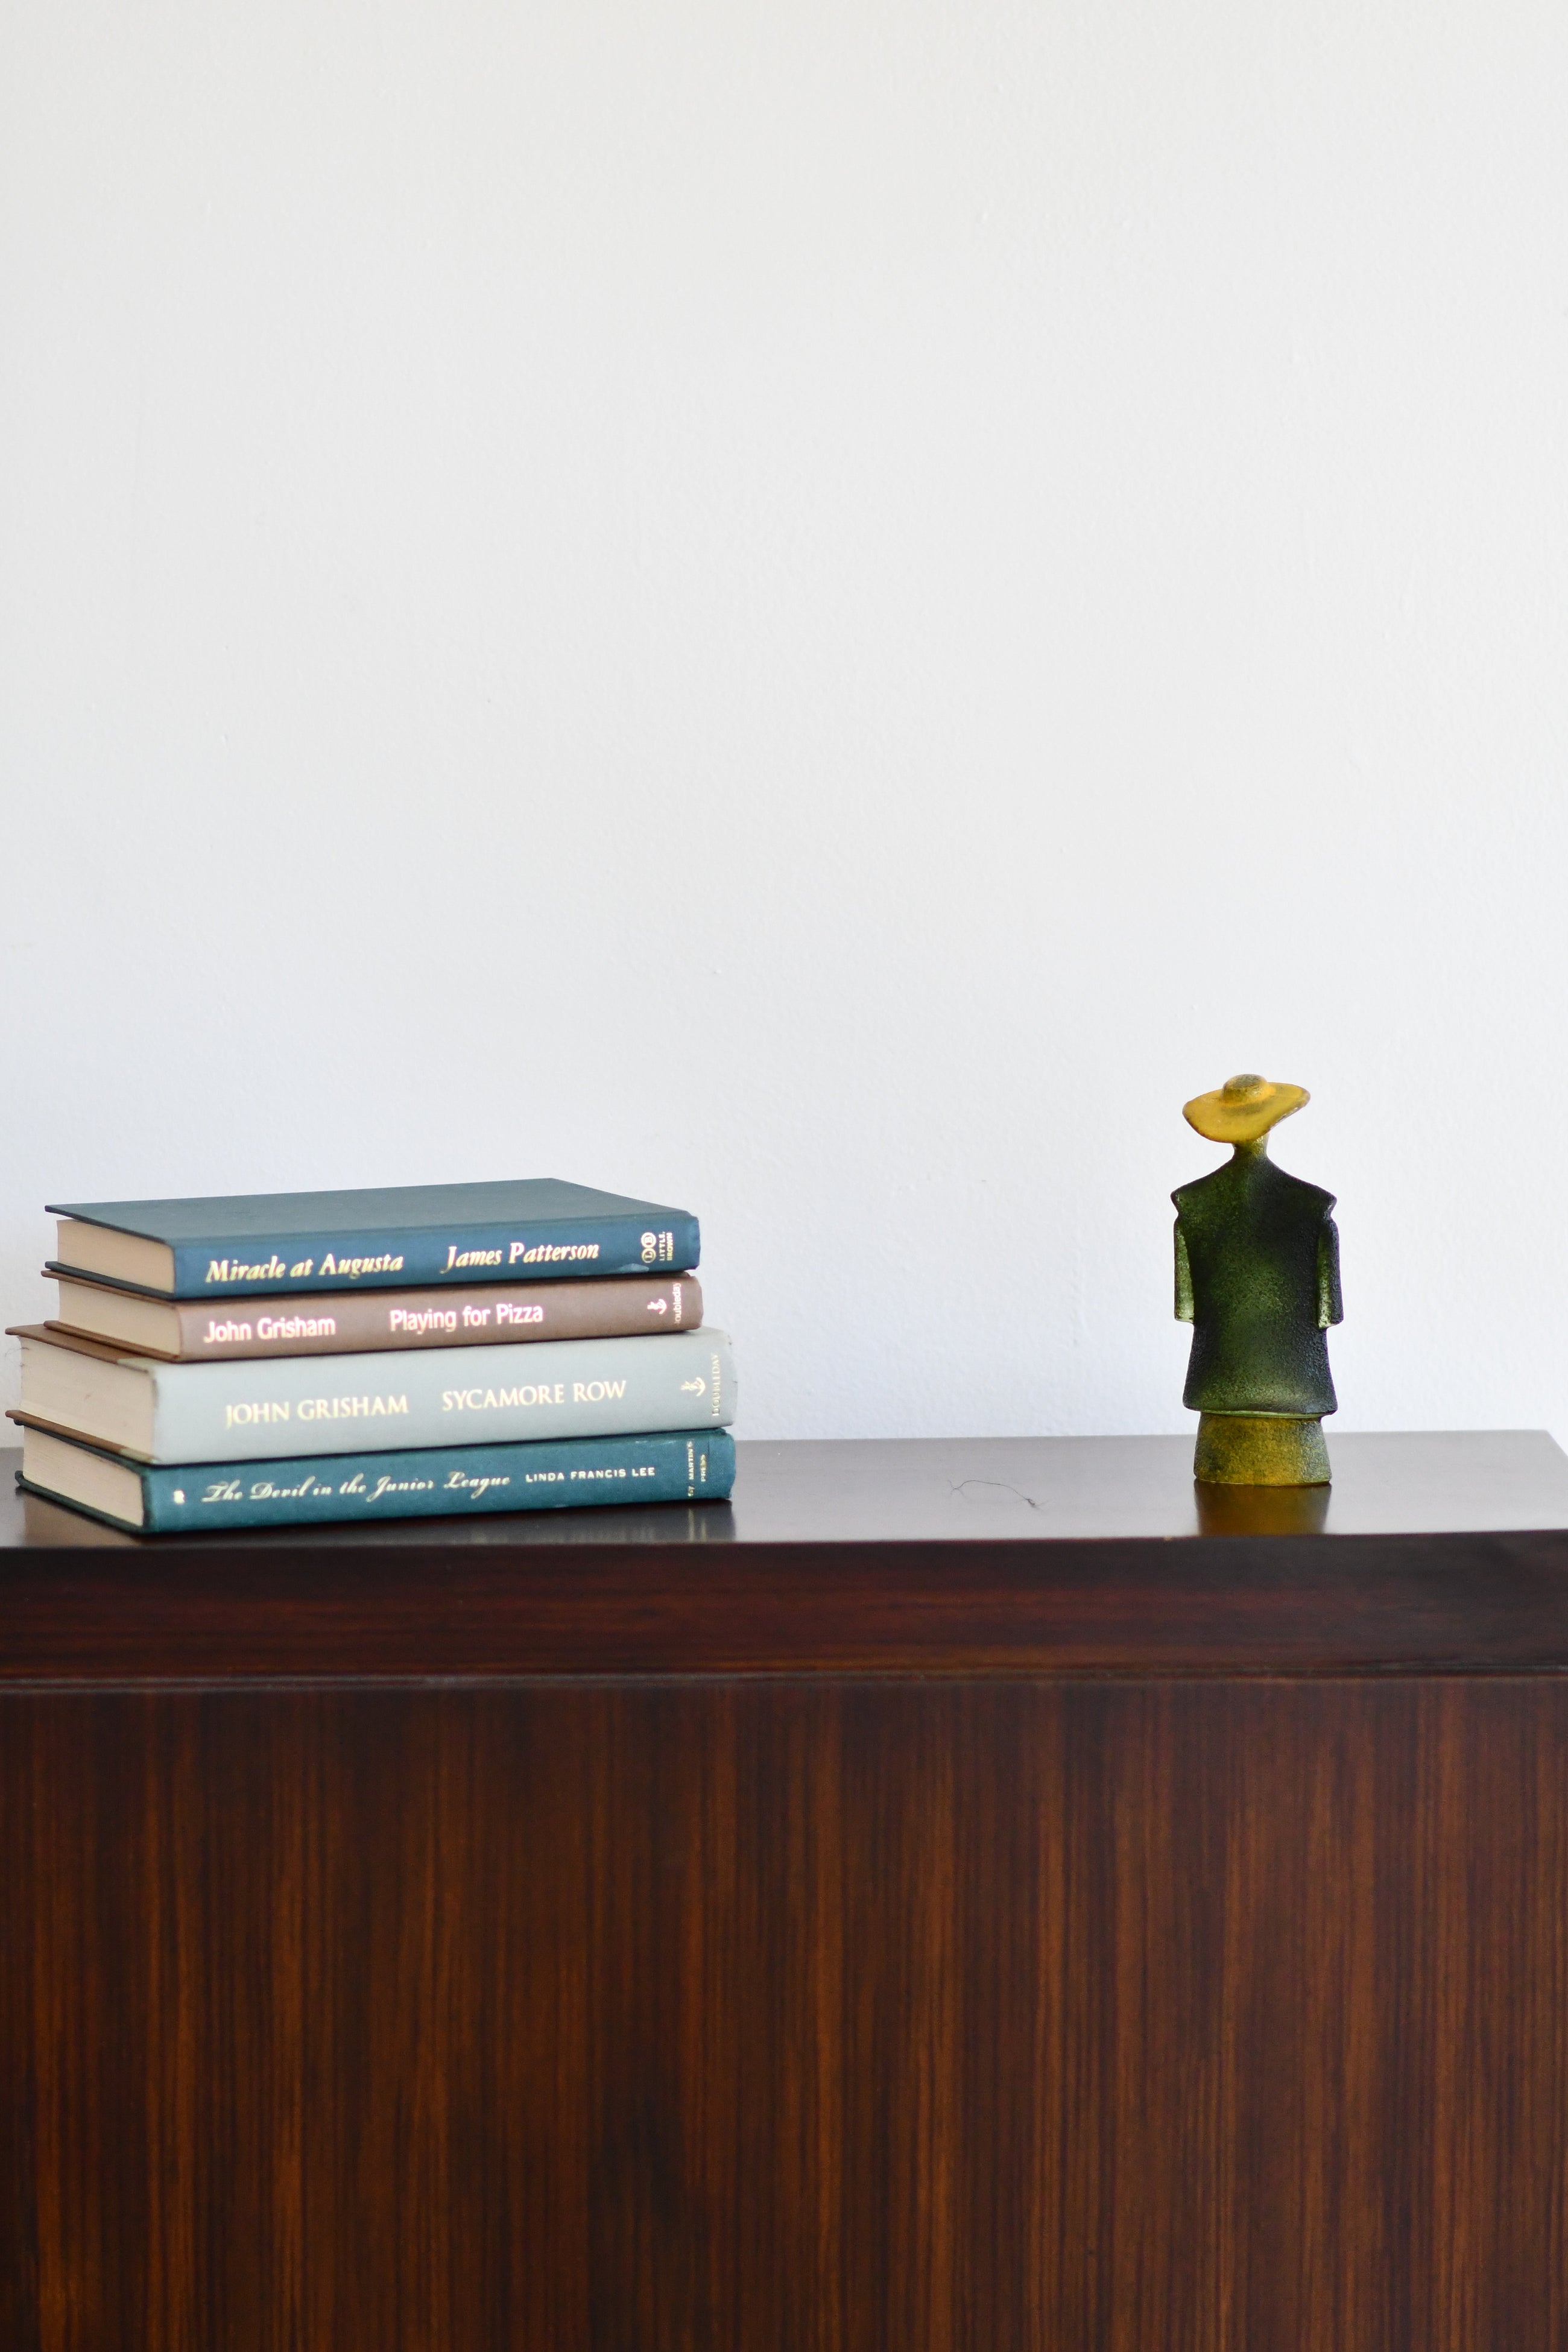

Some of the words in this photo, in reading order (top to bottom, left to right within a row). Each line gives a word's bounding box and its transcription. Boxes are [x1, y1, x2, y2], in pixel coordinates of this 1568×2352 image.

[205, 1255, 286, 1283] Miracle
[289, 1258, 313, 1278] at
[318, 1253, 404, 1280] Augusta
[440, 1245, 502, 1274] James
[509, 1242, 600, 1265] Patterson
[204, 1321, 251, 1344] John
[257, 1316, 336, 1340] Grisham
[390, 1309, 457, 1335] Playing
[463, 1306, 491, 1326] for
[496, 1303, 544, 1324] Pizza
[441, 1383, 564, 1412] SYCAMORE
[574, 1380, 627, 1402] ROW
[226, 1401, 290, 1430] JOHN
[297, 1395, 409, 1421] GRISHAM
[201, 1479, 244, 1503] The
[250, 1476, 317, 1500] Devil
[313, 1482, 332, 1496] in
[339, 1473, 367, 1494] the
[366, 1475, 435, 1503] Junior
[444, 1471, 511, 1500] League
[525, 1470, 564, 1482] LINDA
[571, 1468, 627, 1480] FRANCIS
[631, 1467, 656, 1478] LEE
